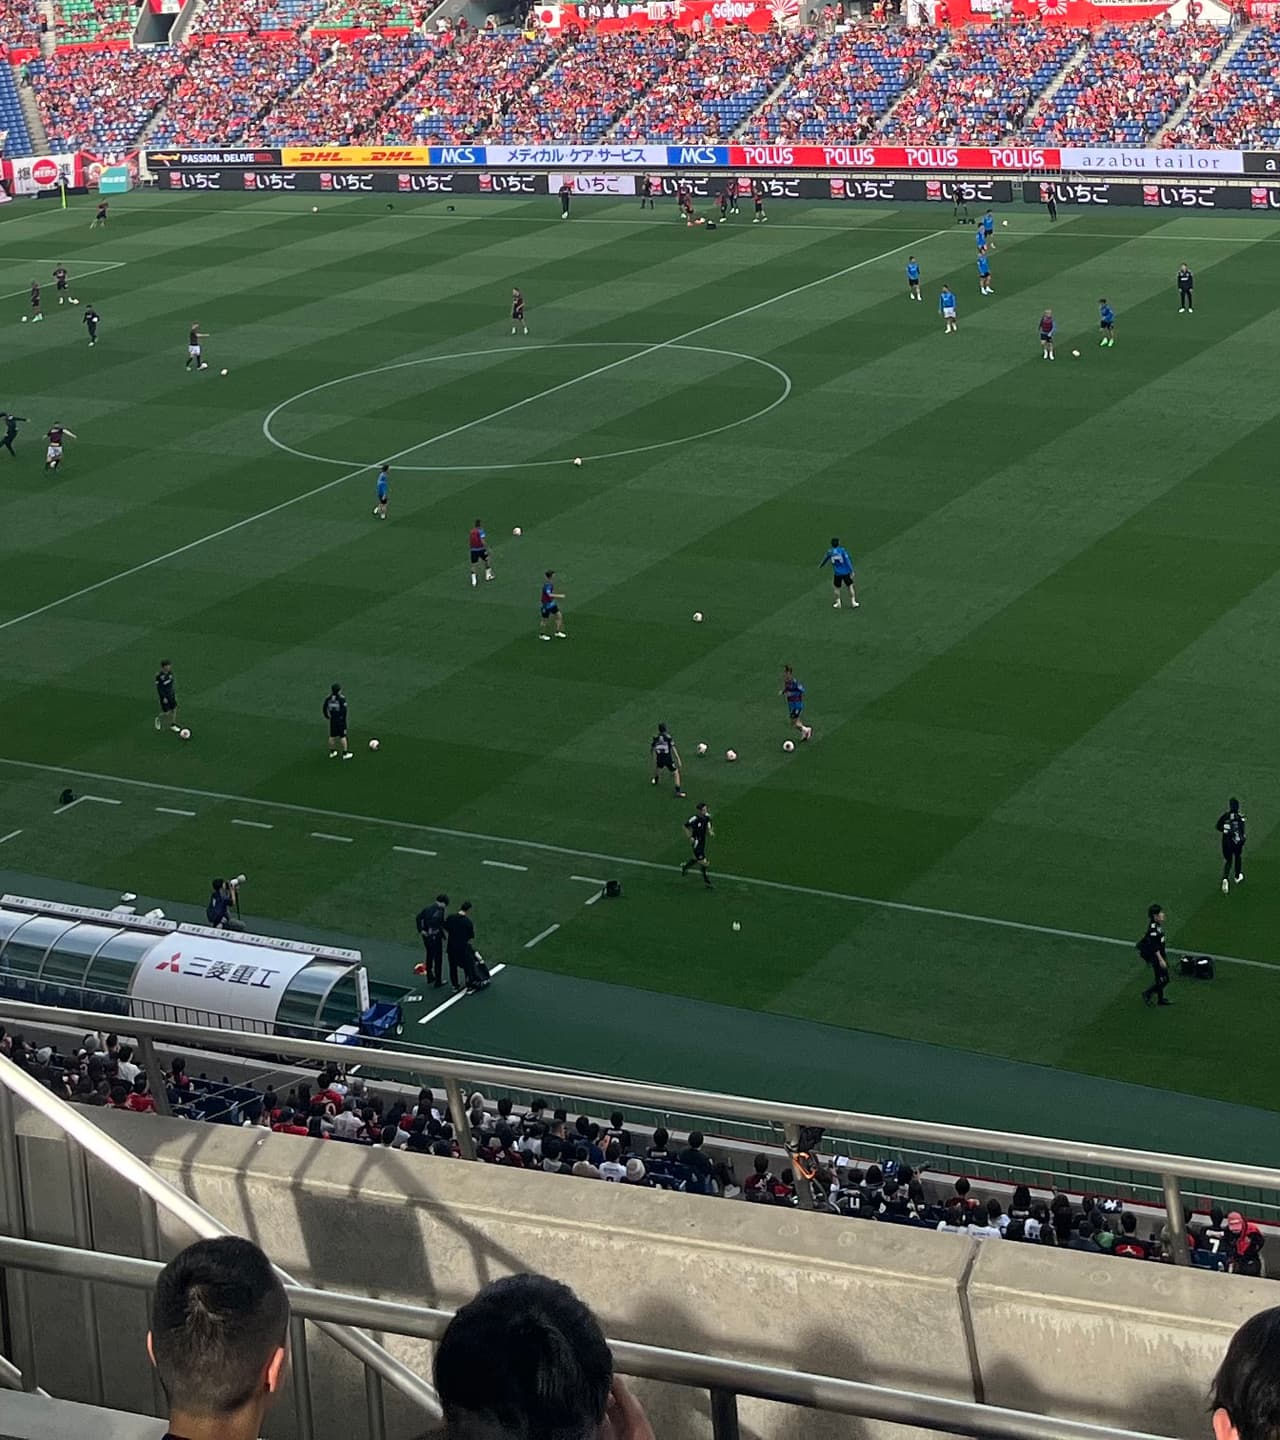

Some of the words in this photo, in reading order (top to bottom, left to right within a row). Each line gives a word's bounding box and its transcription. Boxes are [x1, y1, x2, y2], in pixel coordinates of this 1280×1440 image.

[300, 152, 344, 162] DHL
[371, 151, 415, 161] DHL
[441, 149, 476, 164] MCS
[508, 148, 645, 162] メディカル・ケア・サービス
[680, 148, 717, 164] MCS
[743, 147, 794, 165] POLUS
[824, 148, 875, 165] POLUS
[905, 148, 959, 166] POLUS
[989, 149, 1045, 168] POLUS
[1082, 153, 1146, 168] azabu
[1155, 154, 1221, 170] tailor
[182, 172, 221, 188] いちご
[256, 172, 296, 189] いちご
[332, 173, 373, 190] いちご
[410, 173, 453, 191] いちご
[492, 175, 536, 192] いちご
[576, 176, 620, 193] いちご
[845, 181, 894, 198] いちご
[1057, 183, 1109, 202] いちご
[1160, 187, 1215, 206] いちご
[184, 957, 281, 989] 三菱重工
